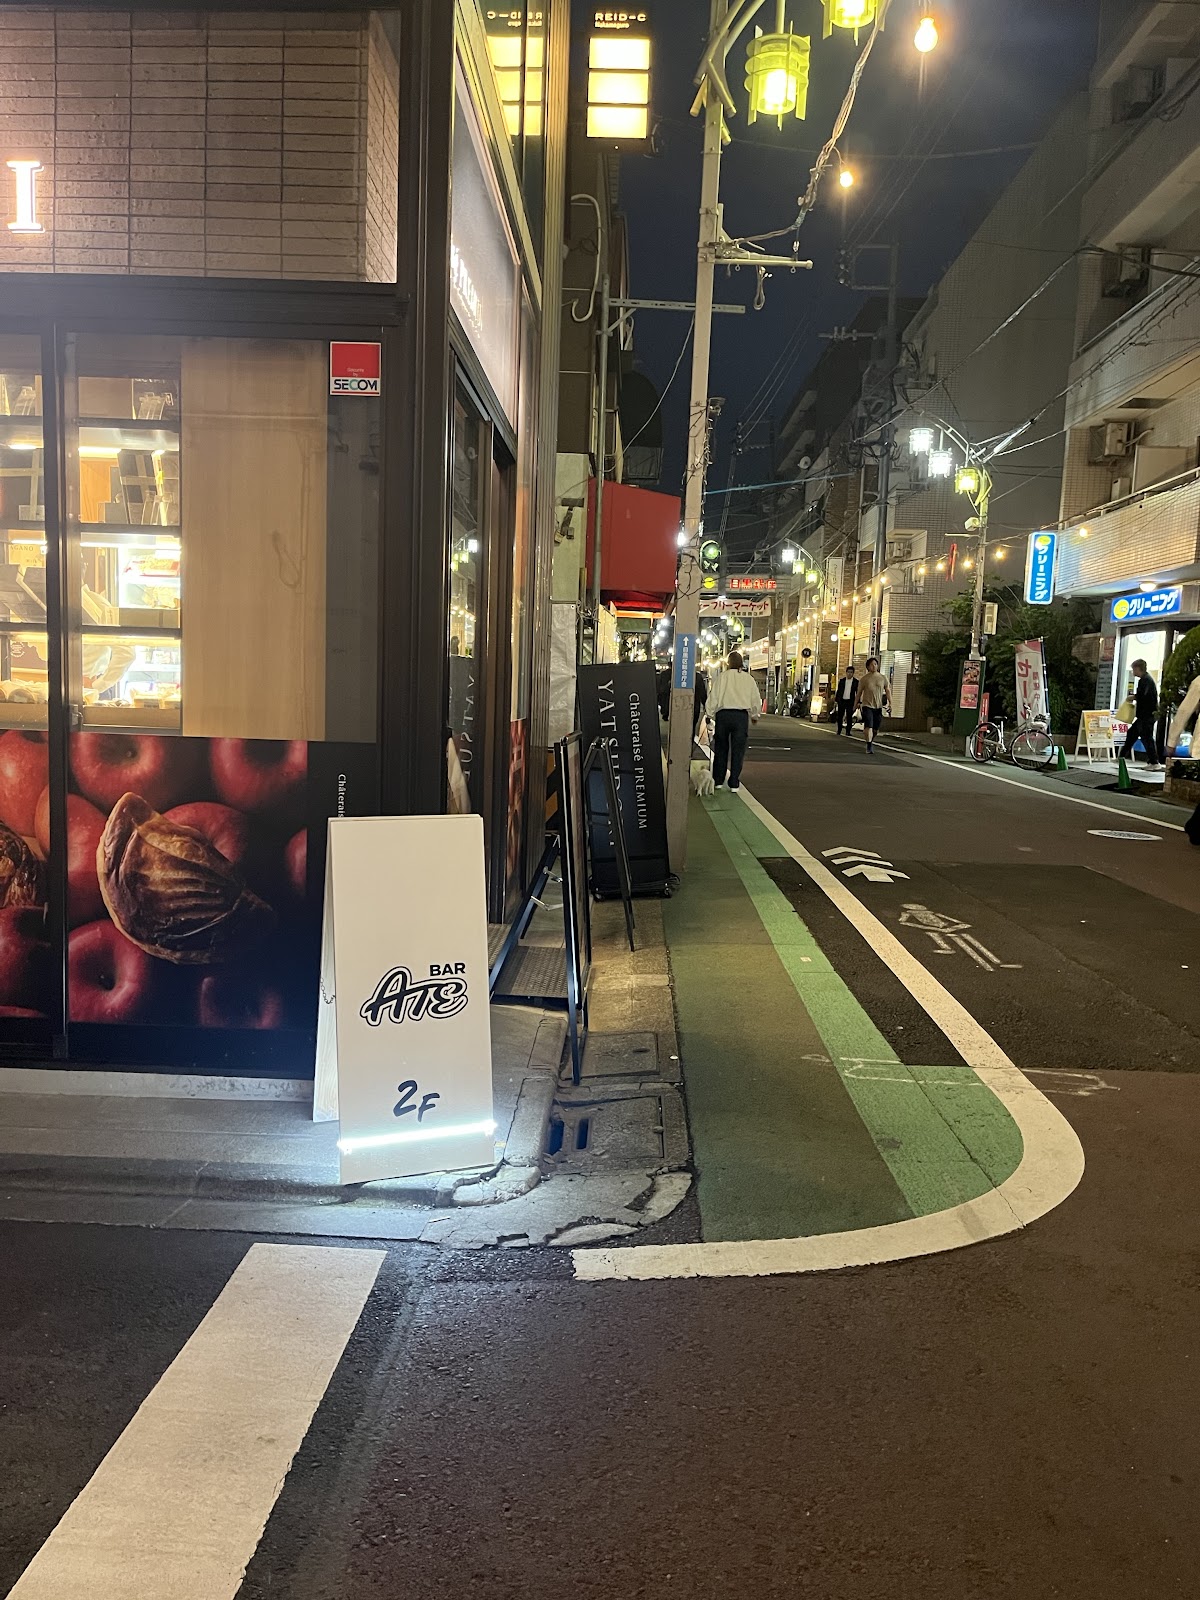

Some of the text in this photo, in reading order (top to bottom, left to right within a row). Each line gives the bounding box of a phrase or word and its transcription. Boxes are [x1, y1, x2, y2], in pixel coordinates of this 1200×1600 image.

[594, 12, 647, 22] REID-C
[333, 379, 377, 391] SECOM
[1034, 545, 1049, 600] クリーニング
[1128, 589, 1179, 616] クリーニング
[633, 766, 648, 830] PREMIUM
[429, 962, 466, 977] BAR
[392, 1079, 441, 1123] 2F
